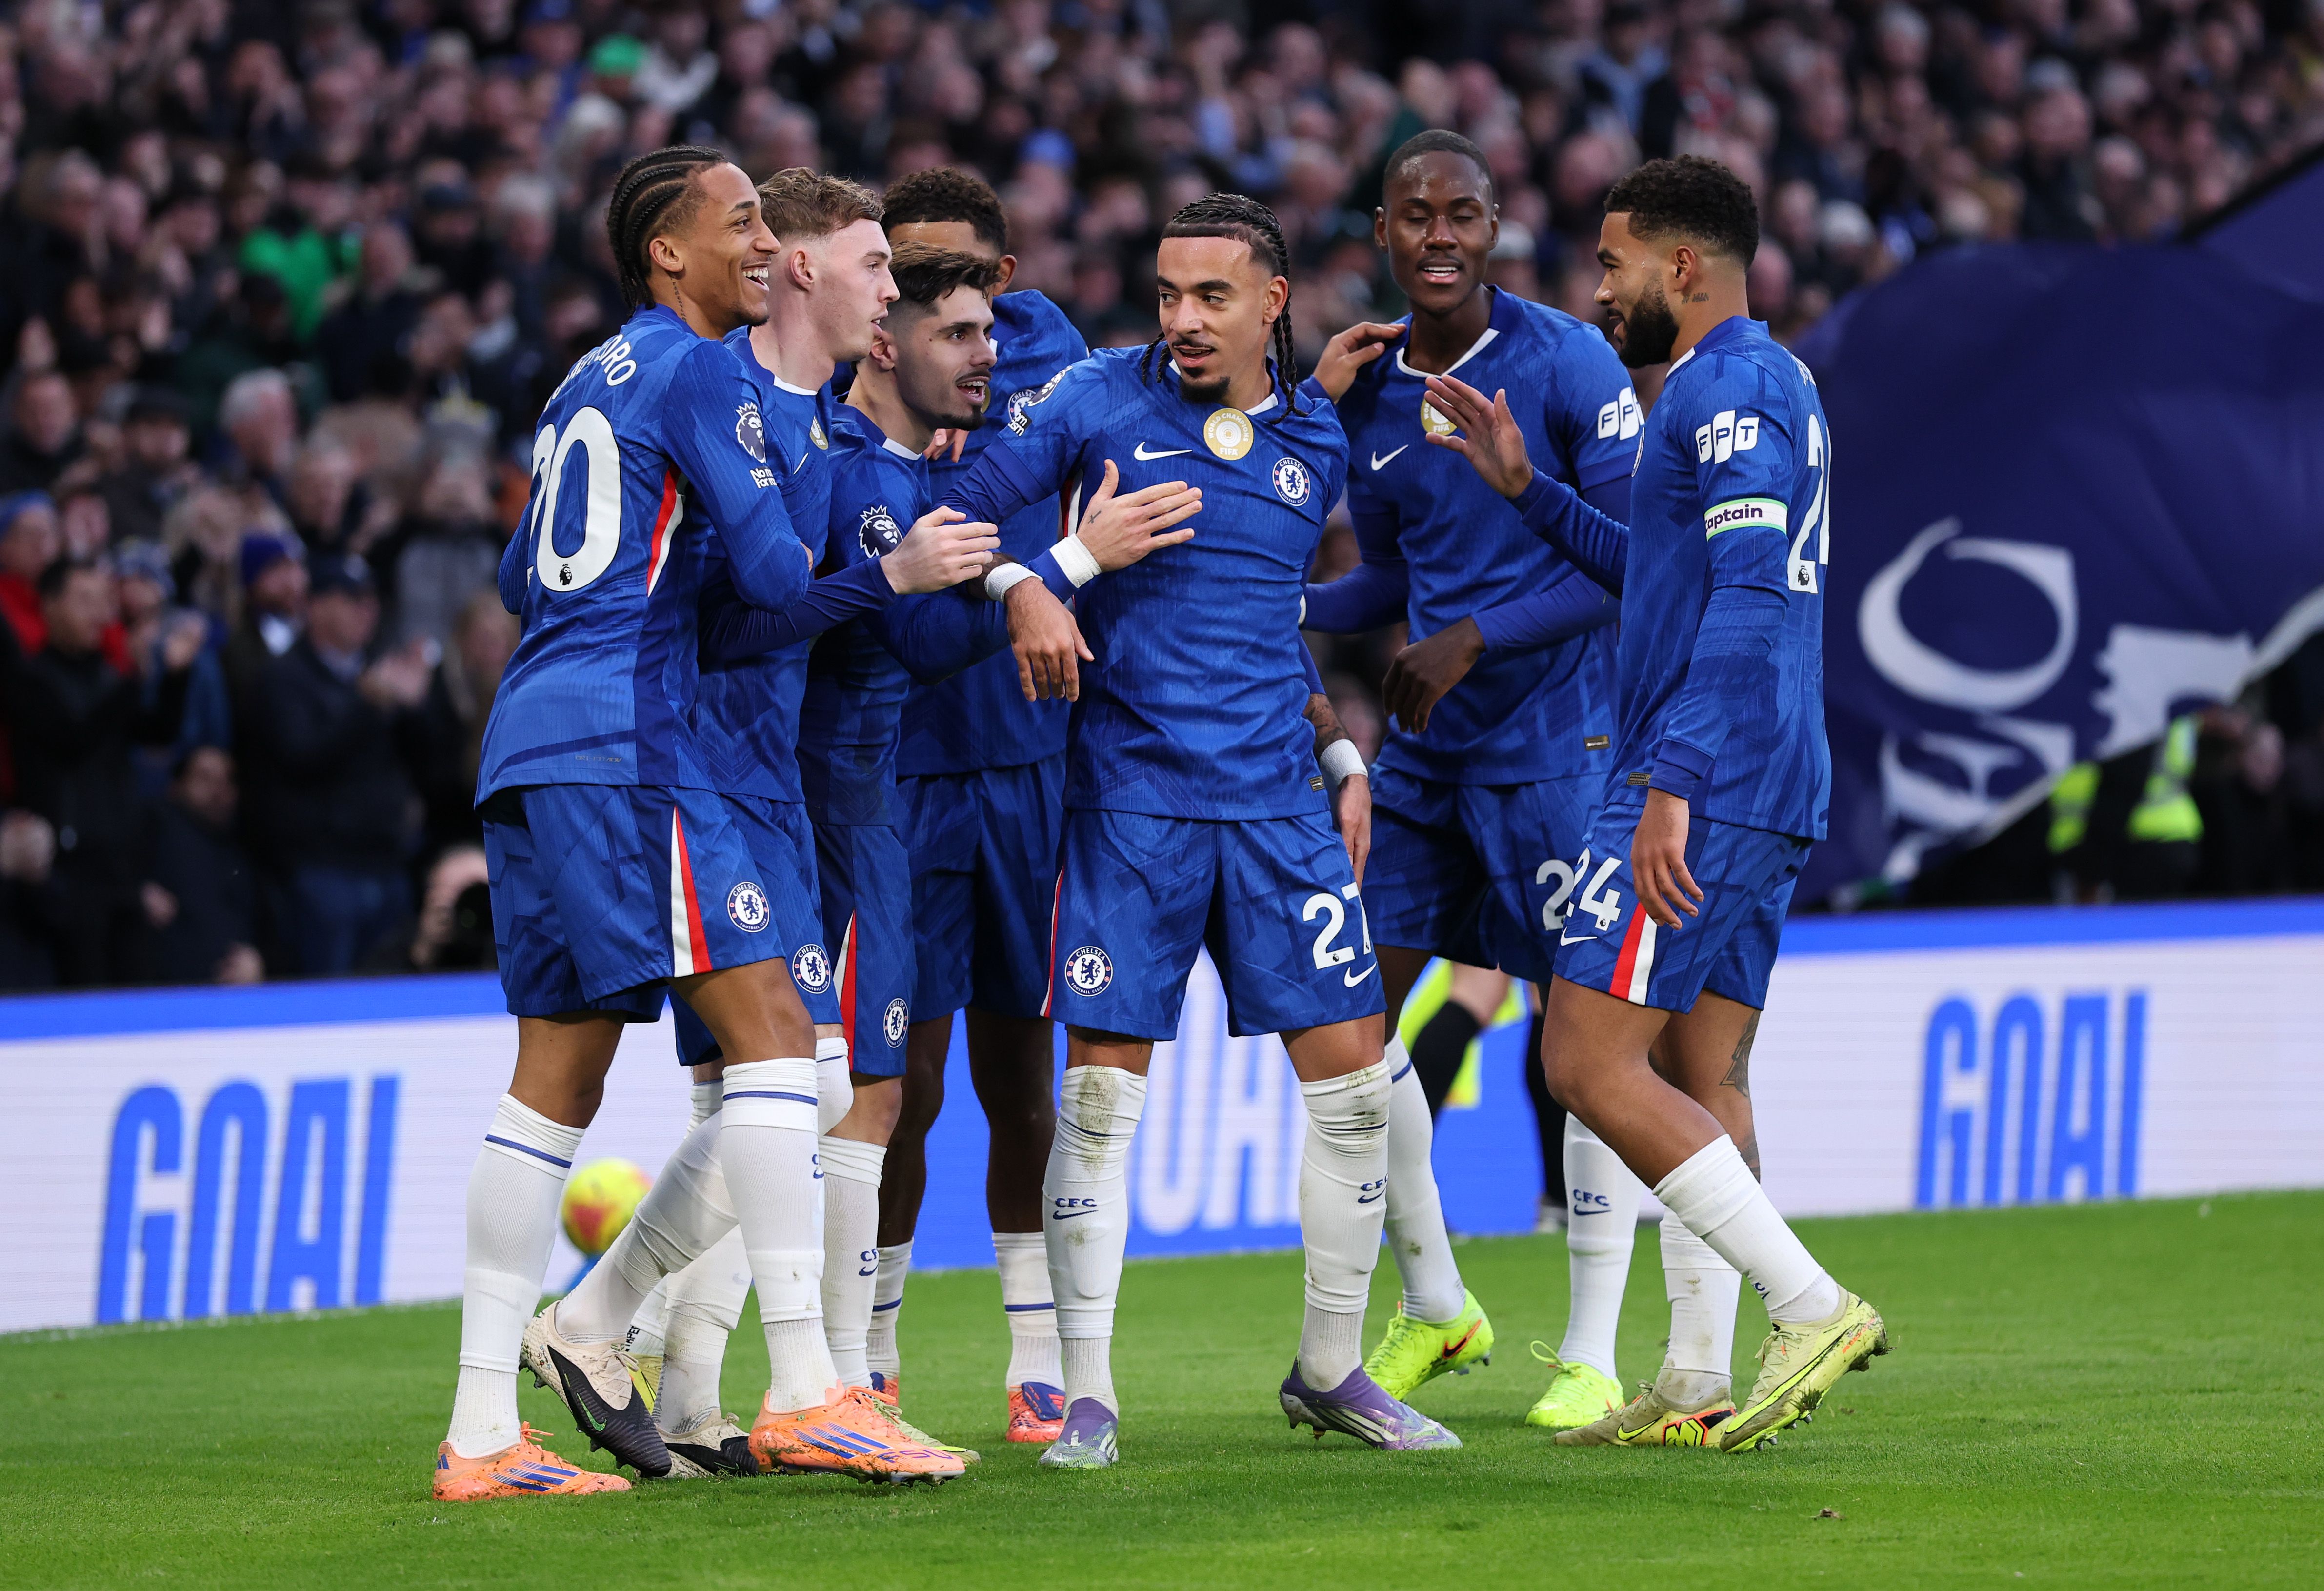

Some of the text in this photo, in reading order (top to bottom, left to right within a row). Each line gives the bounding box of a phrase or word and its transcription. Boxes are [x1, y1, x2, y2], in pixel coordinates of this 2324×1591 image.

[1011, 391, 1033, 403] CHELSE
[1208, 413, 1249, 442] WORLD CHAMPIONS
[1433, 424, 1450, 433] FIFA
[1220, 447, 1239, 456] FIFA
[1279, 459, 1304, 473] CHELSEA
[750, 468, 766, 479] No
[1787, 413, 1833, 595] 2
[733, 884, 759, 897] CHELSEA
[798, 946, 822, 958] CHELSEA
[1076, 948, 1106, 961] CHELSEA
[1070, 982, 1091, 994] FOOTBALL
[889, 1000, 906, 1011] CHELSEA
[1361, 1173, 1388, 1192] CF
[1055, 1197, 1098, 1208] CFC
[1573, 1188, 1610, 1207] CFC
[860, 1248, 878, 1262] CF
